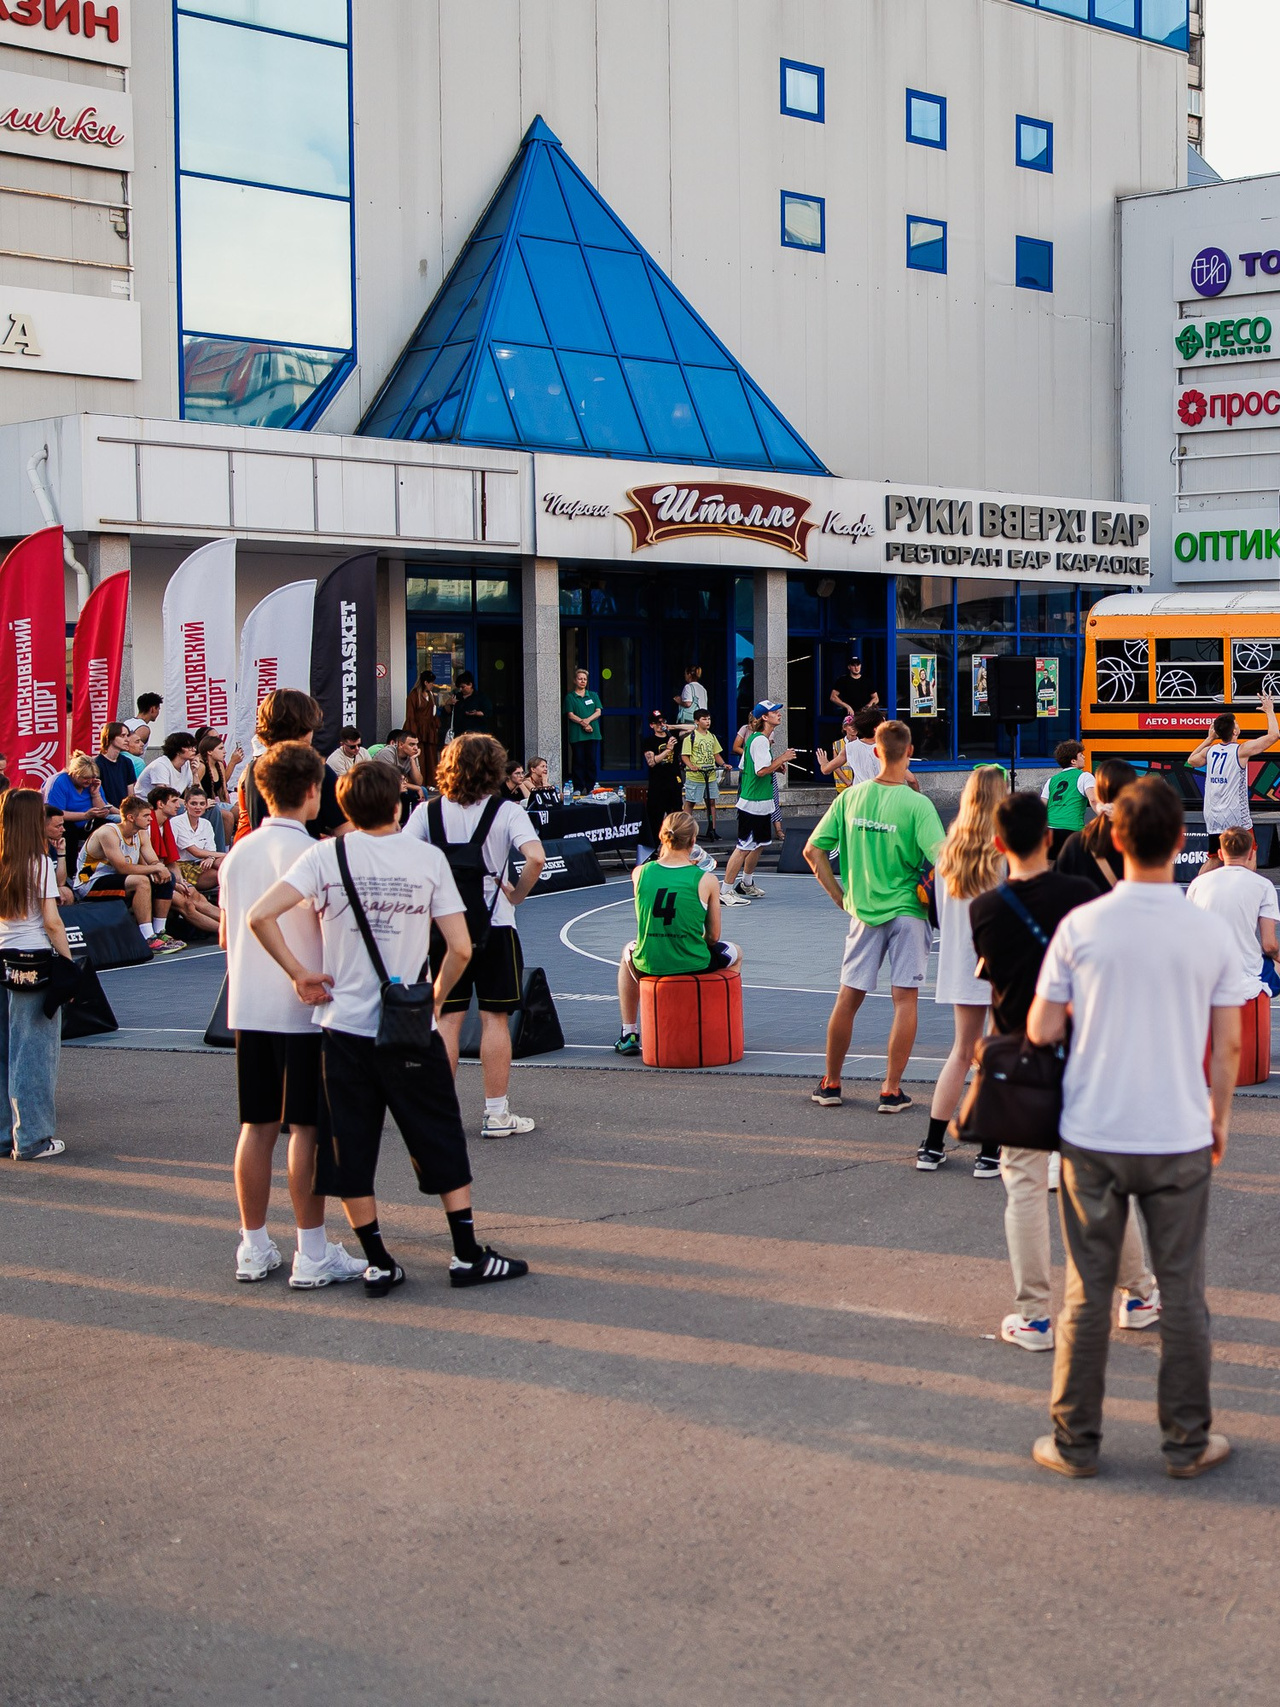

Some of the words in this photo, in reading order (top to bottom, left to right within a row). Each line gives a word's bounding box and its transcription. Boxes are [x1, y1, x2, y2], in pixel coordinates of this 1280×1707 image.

[1205, 316, 1272, 349] РЕСО
[1205, 344, 1271, 358] ГАРАНТИЯ
[543, 491, 611, 521] Пироги
[652, 485, 797, 529] Штолле
[822, 509, 877, 545] Кафе
[885, 494, 973, 535] РУКИ
[1092, 511, 1149, 547] БАР
[885, 541, 1002, 567] РЕСТОРАН
[1008, 549, 1051, 569] БАР
[1056, 552, 1150, 575] КАРАОКЕ
[1174, 527, 1280, 563] ОПТИК
[9, 617, 34, 737] МОСКОВСКИЙ
[180, 621, 208, 729] МОСКОВСКИЙ
[340, 600, 357, 729] EETBASKET
[33, 679, 59, 735] СПОРТ
[208, 677, 229, 727] СПОРТ
[1145, 717, 1169, 725] ЛЕТО
[1171, 717, 1177, 725] В
[1212, 751, 1228, 775] 77
[1052, 780, 1069, 802] 2
[652, 887, 678, 927] 4
